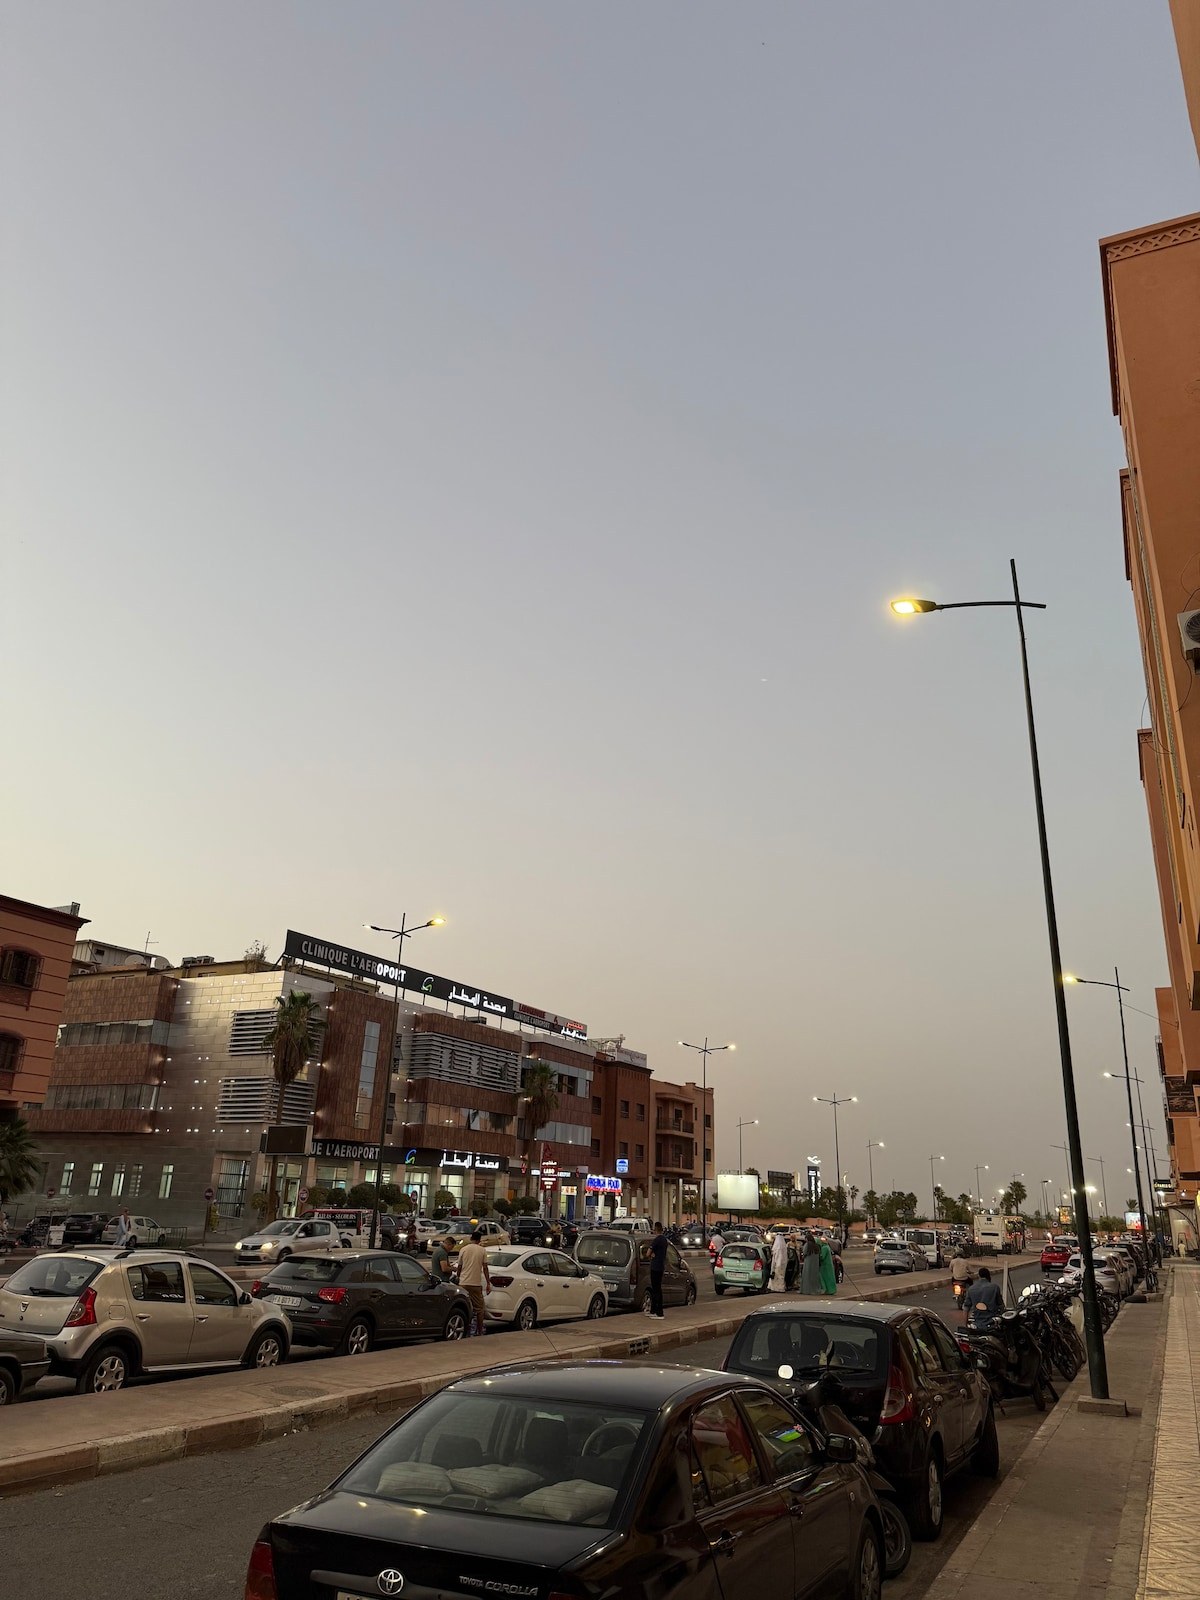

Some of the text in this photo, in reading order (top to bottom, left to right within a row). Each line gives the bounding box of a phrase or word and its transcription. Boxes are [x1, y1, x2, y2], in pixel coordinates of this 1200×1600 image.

[301, 940, 406, 982] CLINIQUE L'AEROPORT
[448, 985, 507, 1013] مصحة المطار
[326, 1143, 380, 1160] L'AEROPORT
[439, 1152, 499, 1169] مصحة المطار
[459, 1575, 538, 1596] TOYOTA COROLLA
